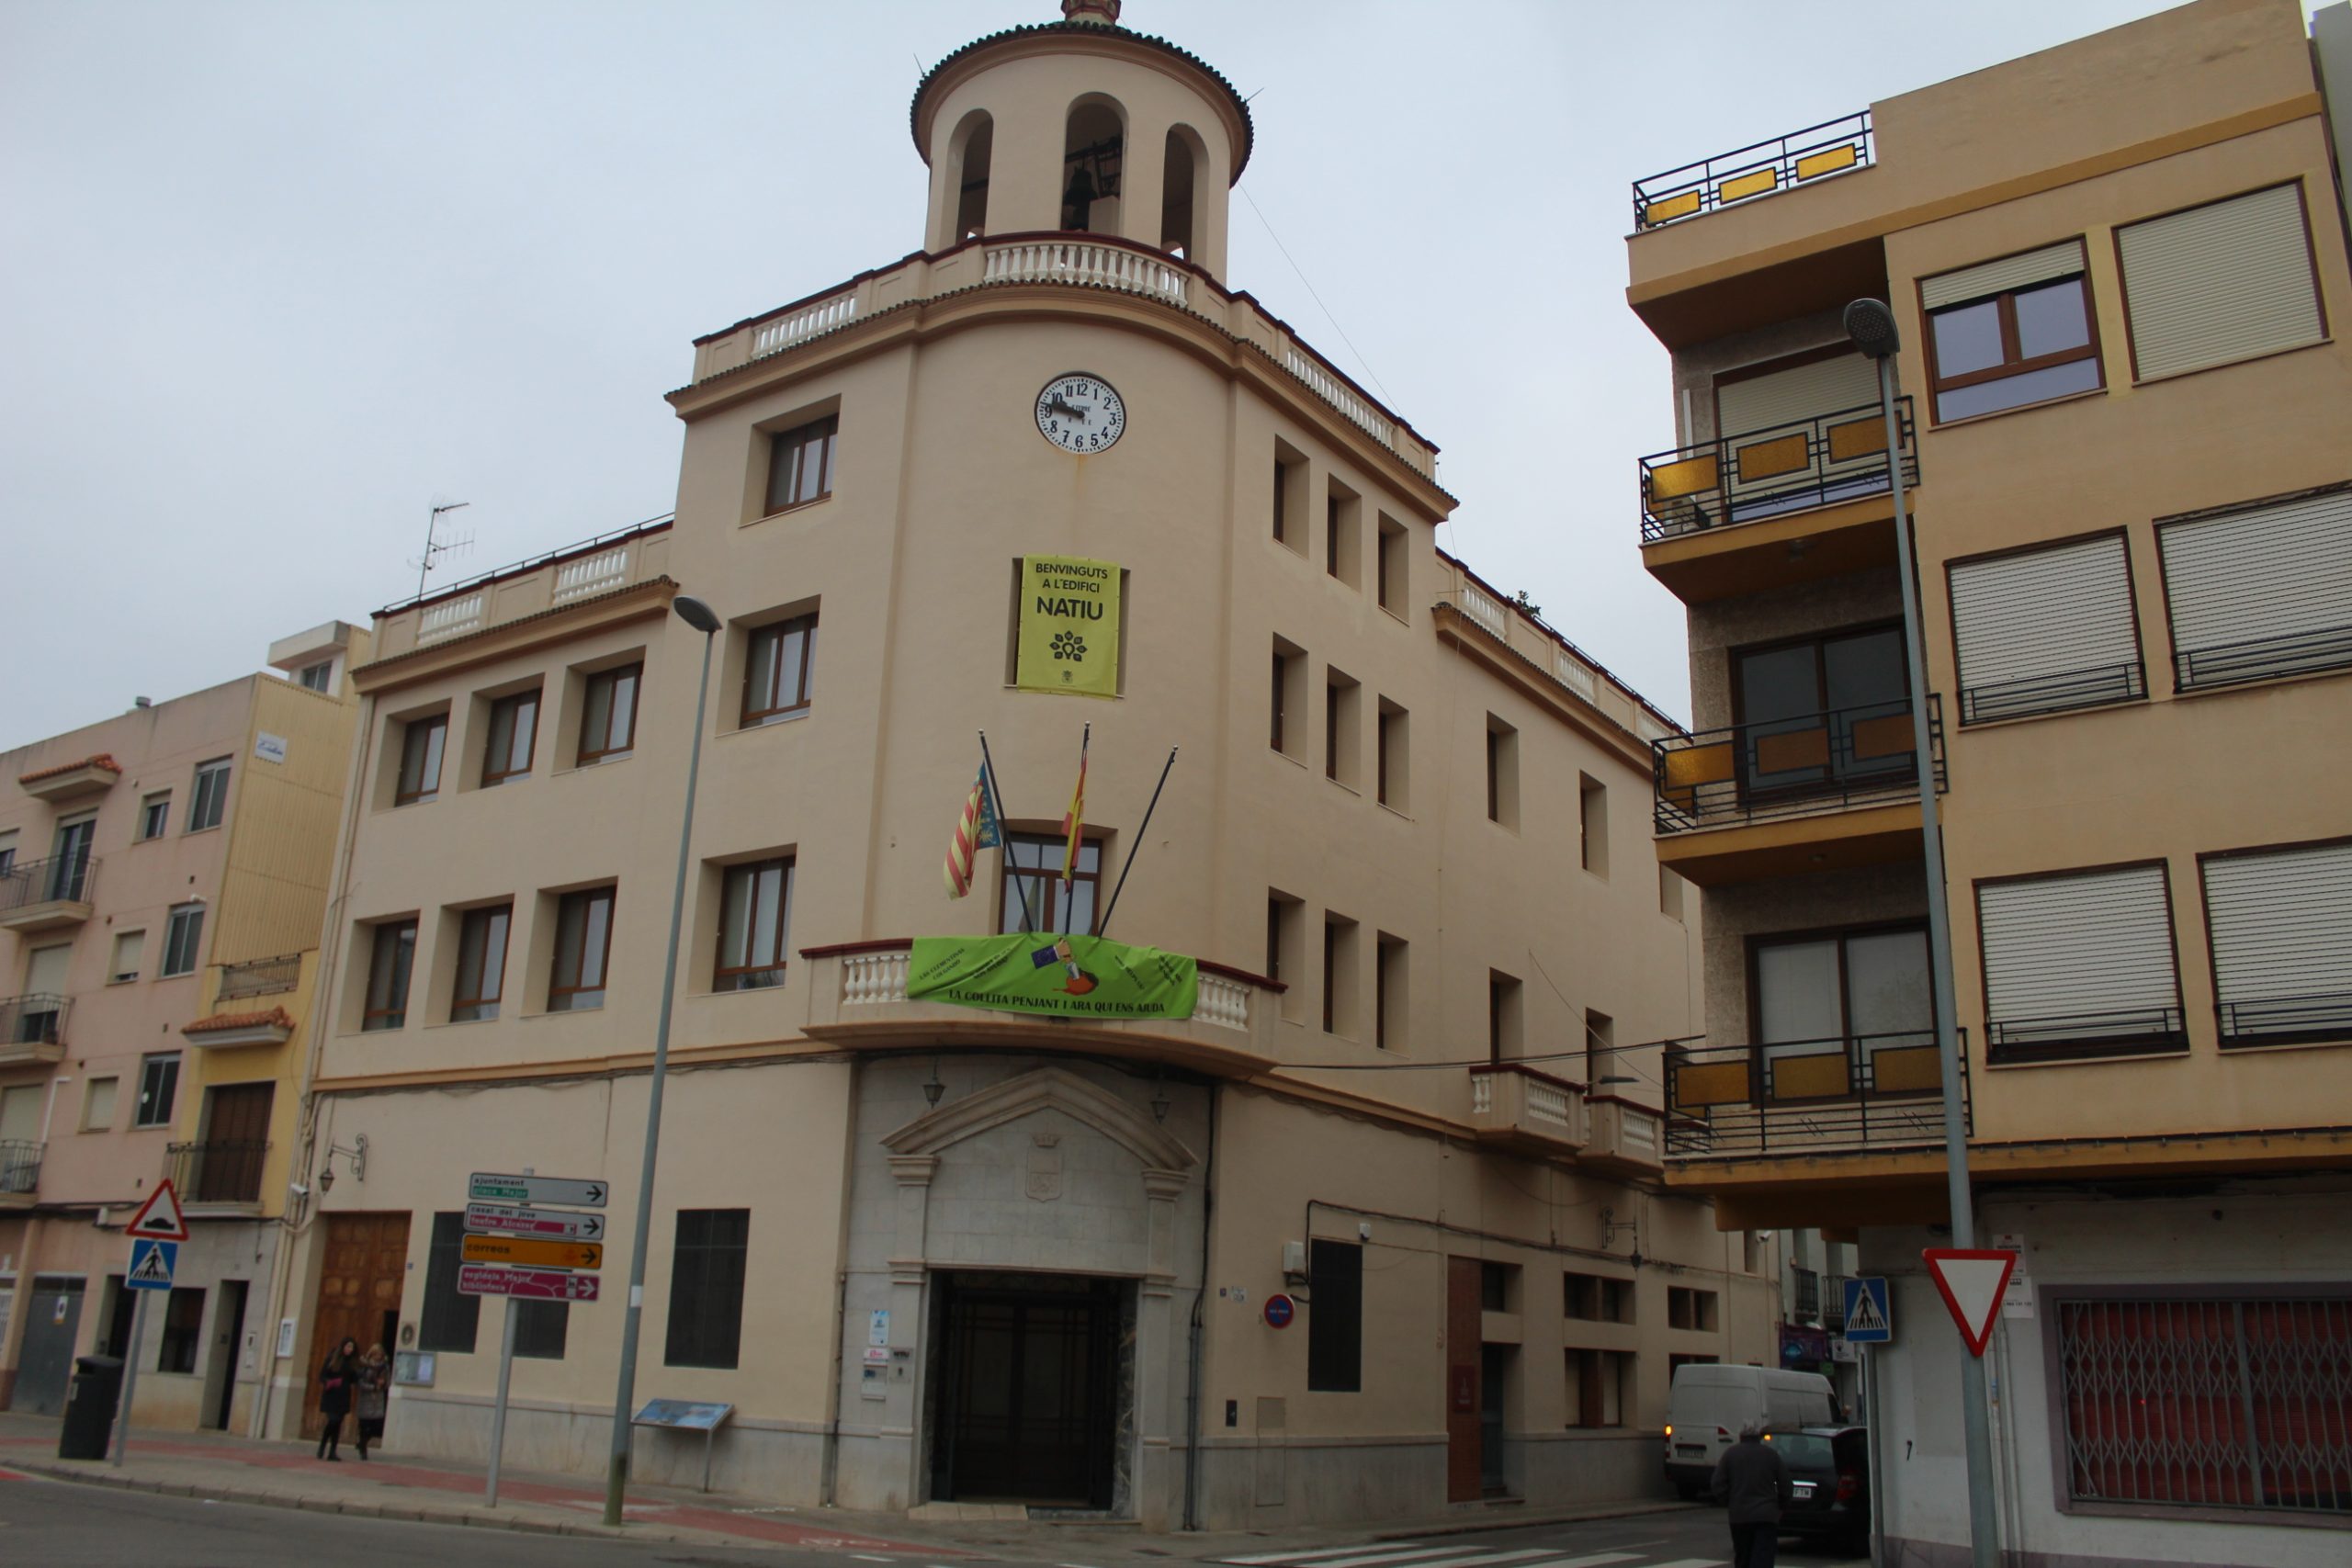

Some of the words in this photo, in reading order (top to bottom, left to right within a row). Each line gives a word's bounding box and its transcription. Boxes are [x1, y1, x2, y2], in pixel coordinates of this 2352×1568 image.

[1066, 385, 1073, 397] 11
[1077, 383, 1088, 396] 12
[1093, 388, 1098, 400] 1
[1052, 392, 1063, 405] 10
[1103, 397, 1111, 410] 2
[1045, 404, 1052, 418] 9
[1109, 412, 1116, 425] 3
[1050, 421, 1057, 434] 8
[1102, 426, 1108, 439] 4
[1062, 430, 1070, 443] 7
[1075, 435, 1083, 447] 6
[1091, 434, 1098, 446] 5
[1035, 563, 1108, 579] BENVINGUTS
[1043, 579, 1050, 589] A
[1036, 596, 1103, 620] NATIU
[949, 989, 961, 999] LA
[1012, 996, 1059, 1009] PENJANT
[1063, 999, 1068, 1010] I
[1069, 1000, 1091, 1010] ARA
[1094, 1001, 1113, 1013] QUI
[1115, 1002, 1134, 1012] ENS
[474, 1178, 525, 1187] ajuntament
[467, 1244, 511, 1254] correos
